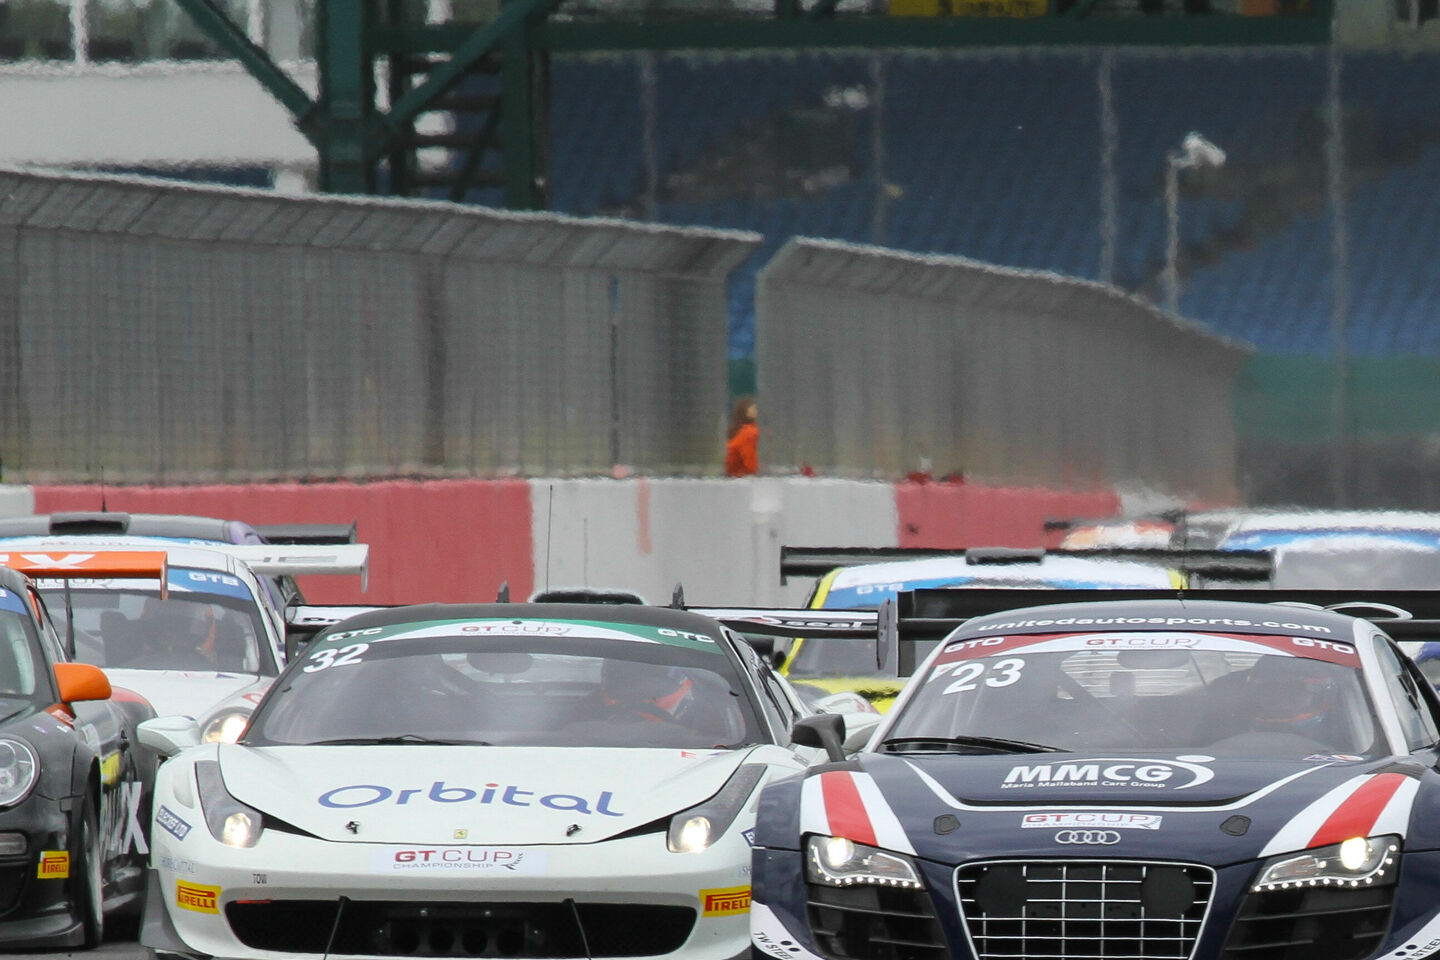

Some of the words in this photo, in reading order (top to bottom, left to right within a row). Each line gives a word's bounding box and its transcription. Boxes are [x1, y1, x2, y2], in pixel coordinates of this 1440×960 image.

[188, 571, 240, 587] GTB
[502, 626, 562, 634] CUP
[978, 616, 1331, 634] unitedautosports.com
[326, 627, 383, 642] GTC
[657, 627, 717, 644] GTC
[1085, 638, 1124, 646] GT
[1129, 638, 1193, 646] CUP
[943, 636, 1005, 653] GTO
[1291, 637, 1355, 654] GTO
[303, 643, 370, 673] 32
[942, 658, 1026, 695] 23
[1003, 764, 1174, 783] MMCG
[317, 781, 625, 817] Orbital
[1025, 814, 1070, 823] GT
[1074, 813, 1149, 823] CUP
[394, 850, 437, 863] GT
[442, 850, 512, 863] CUP
[42, 857, 67, 874] PIRELLI
[177, 886, 217, 909] PIRELLI
[765, 942, 795, 960] STEEL
